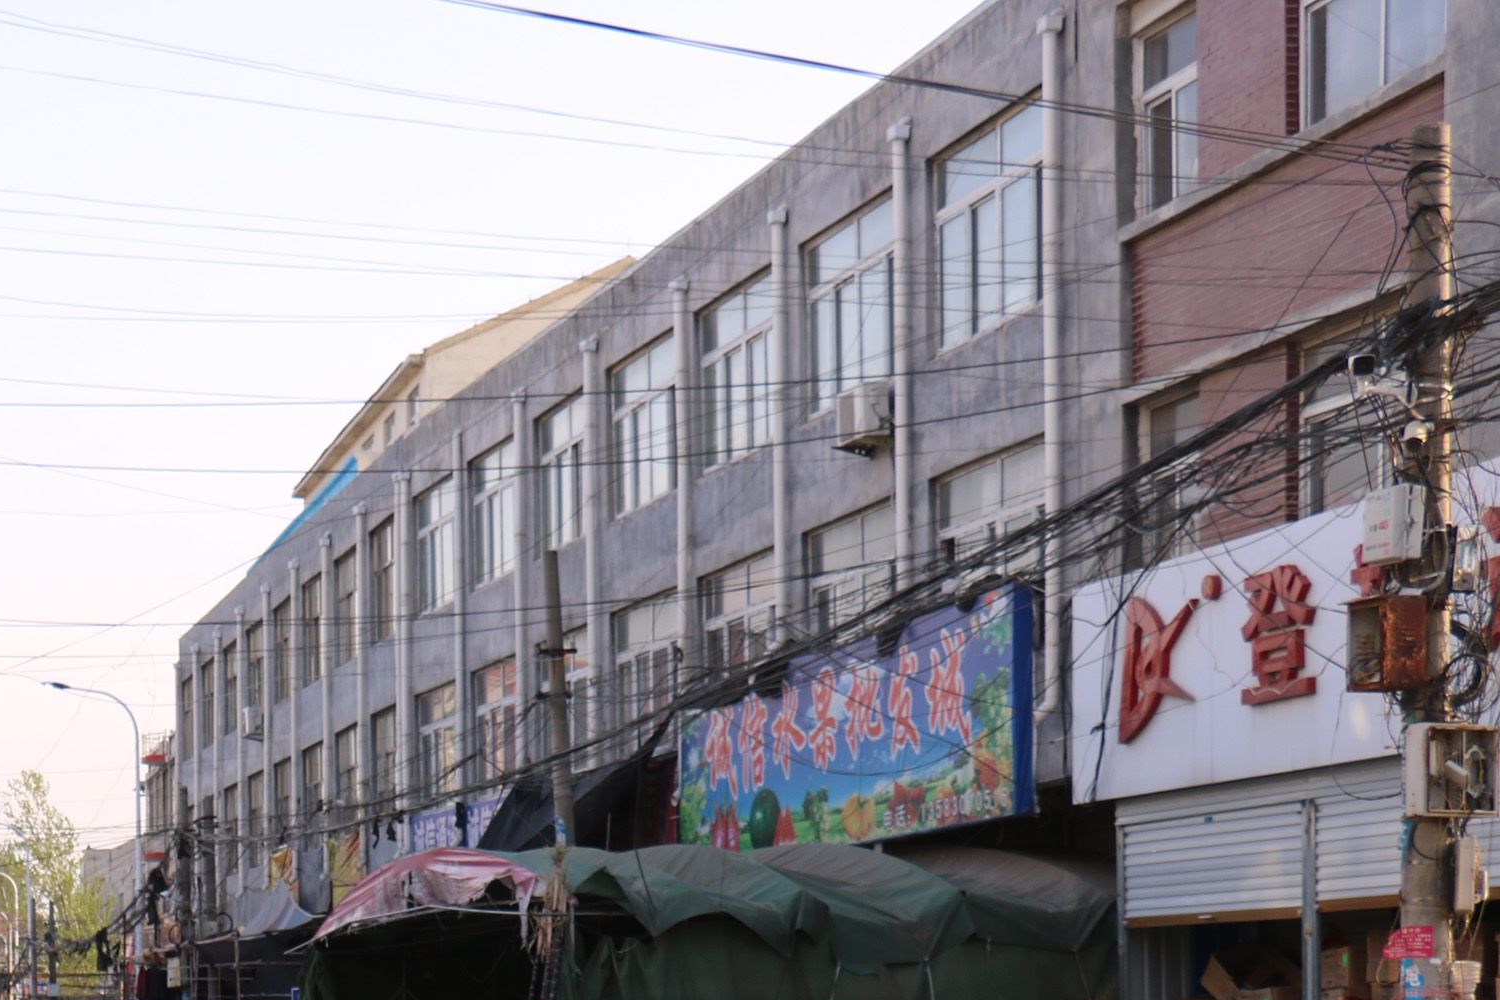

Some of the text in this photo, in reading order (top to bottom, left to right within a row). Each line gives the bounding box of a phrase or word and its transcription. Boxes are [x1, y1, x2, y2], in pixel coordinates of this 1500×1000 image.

[1242, 564, 1318, 706] 登
[706, 628, 972, 800] 诚信水果批发城
